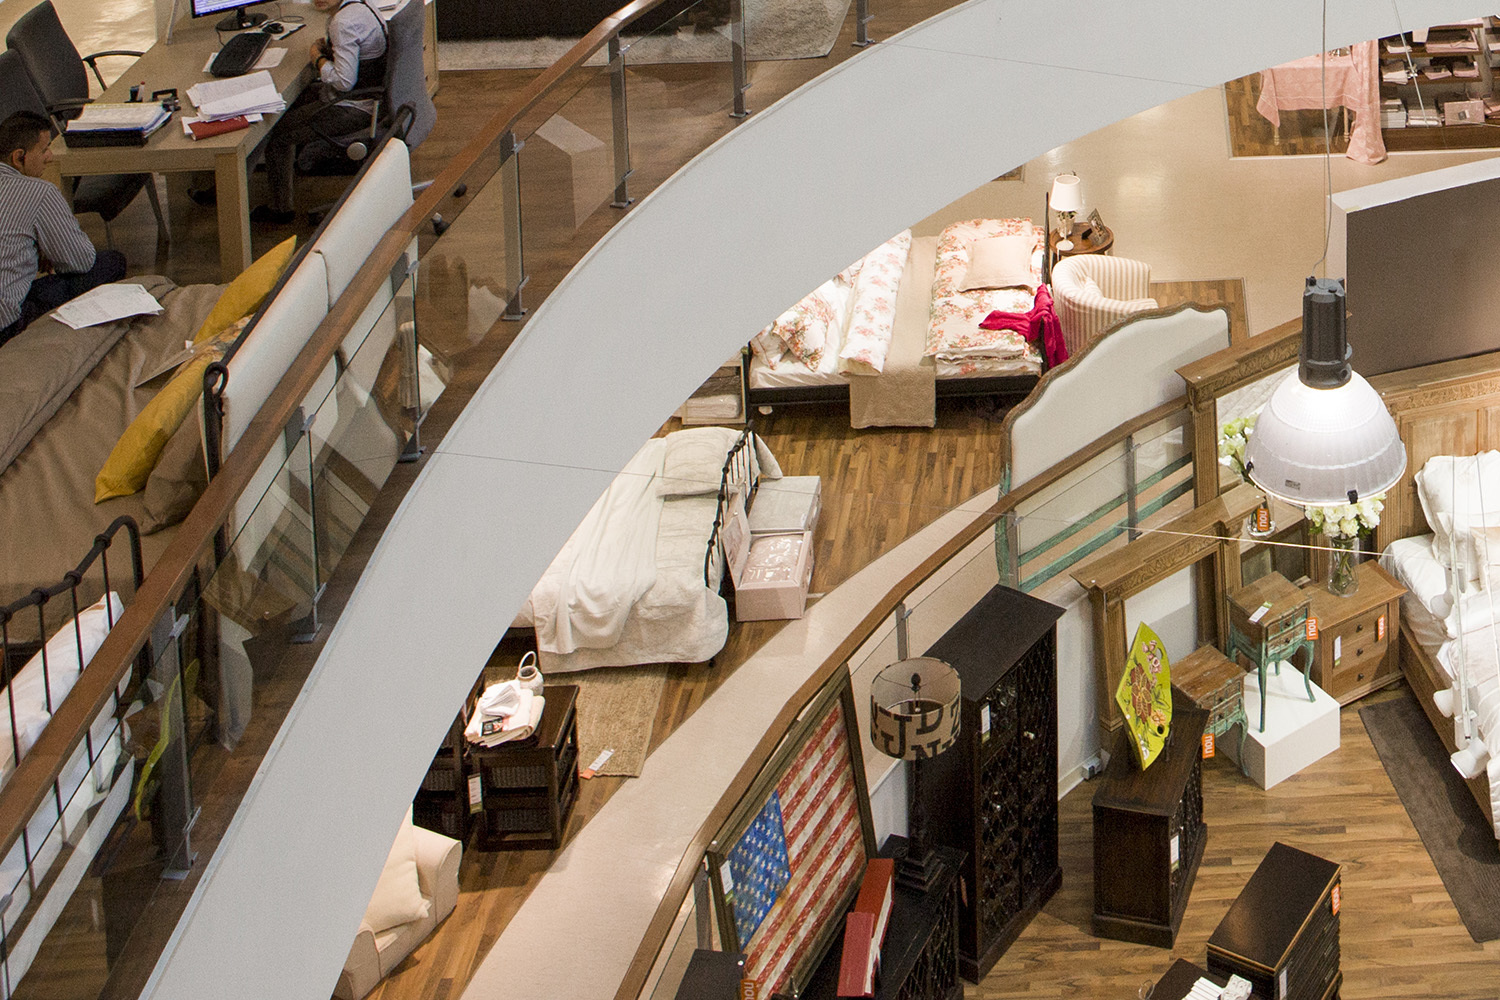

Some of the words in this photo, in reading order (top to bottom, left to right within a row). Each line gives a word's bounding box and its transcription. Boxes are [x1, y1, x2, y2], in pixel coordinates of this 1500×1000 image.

[1259, 510, 1268, 528] nou
[1308, 619, 1317, 636] nou
[1204, 735, 1213, 753] nou
